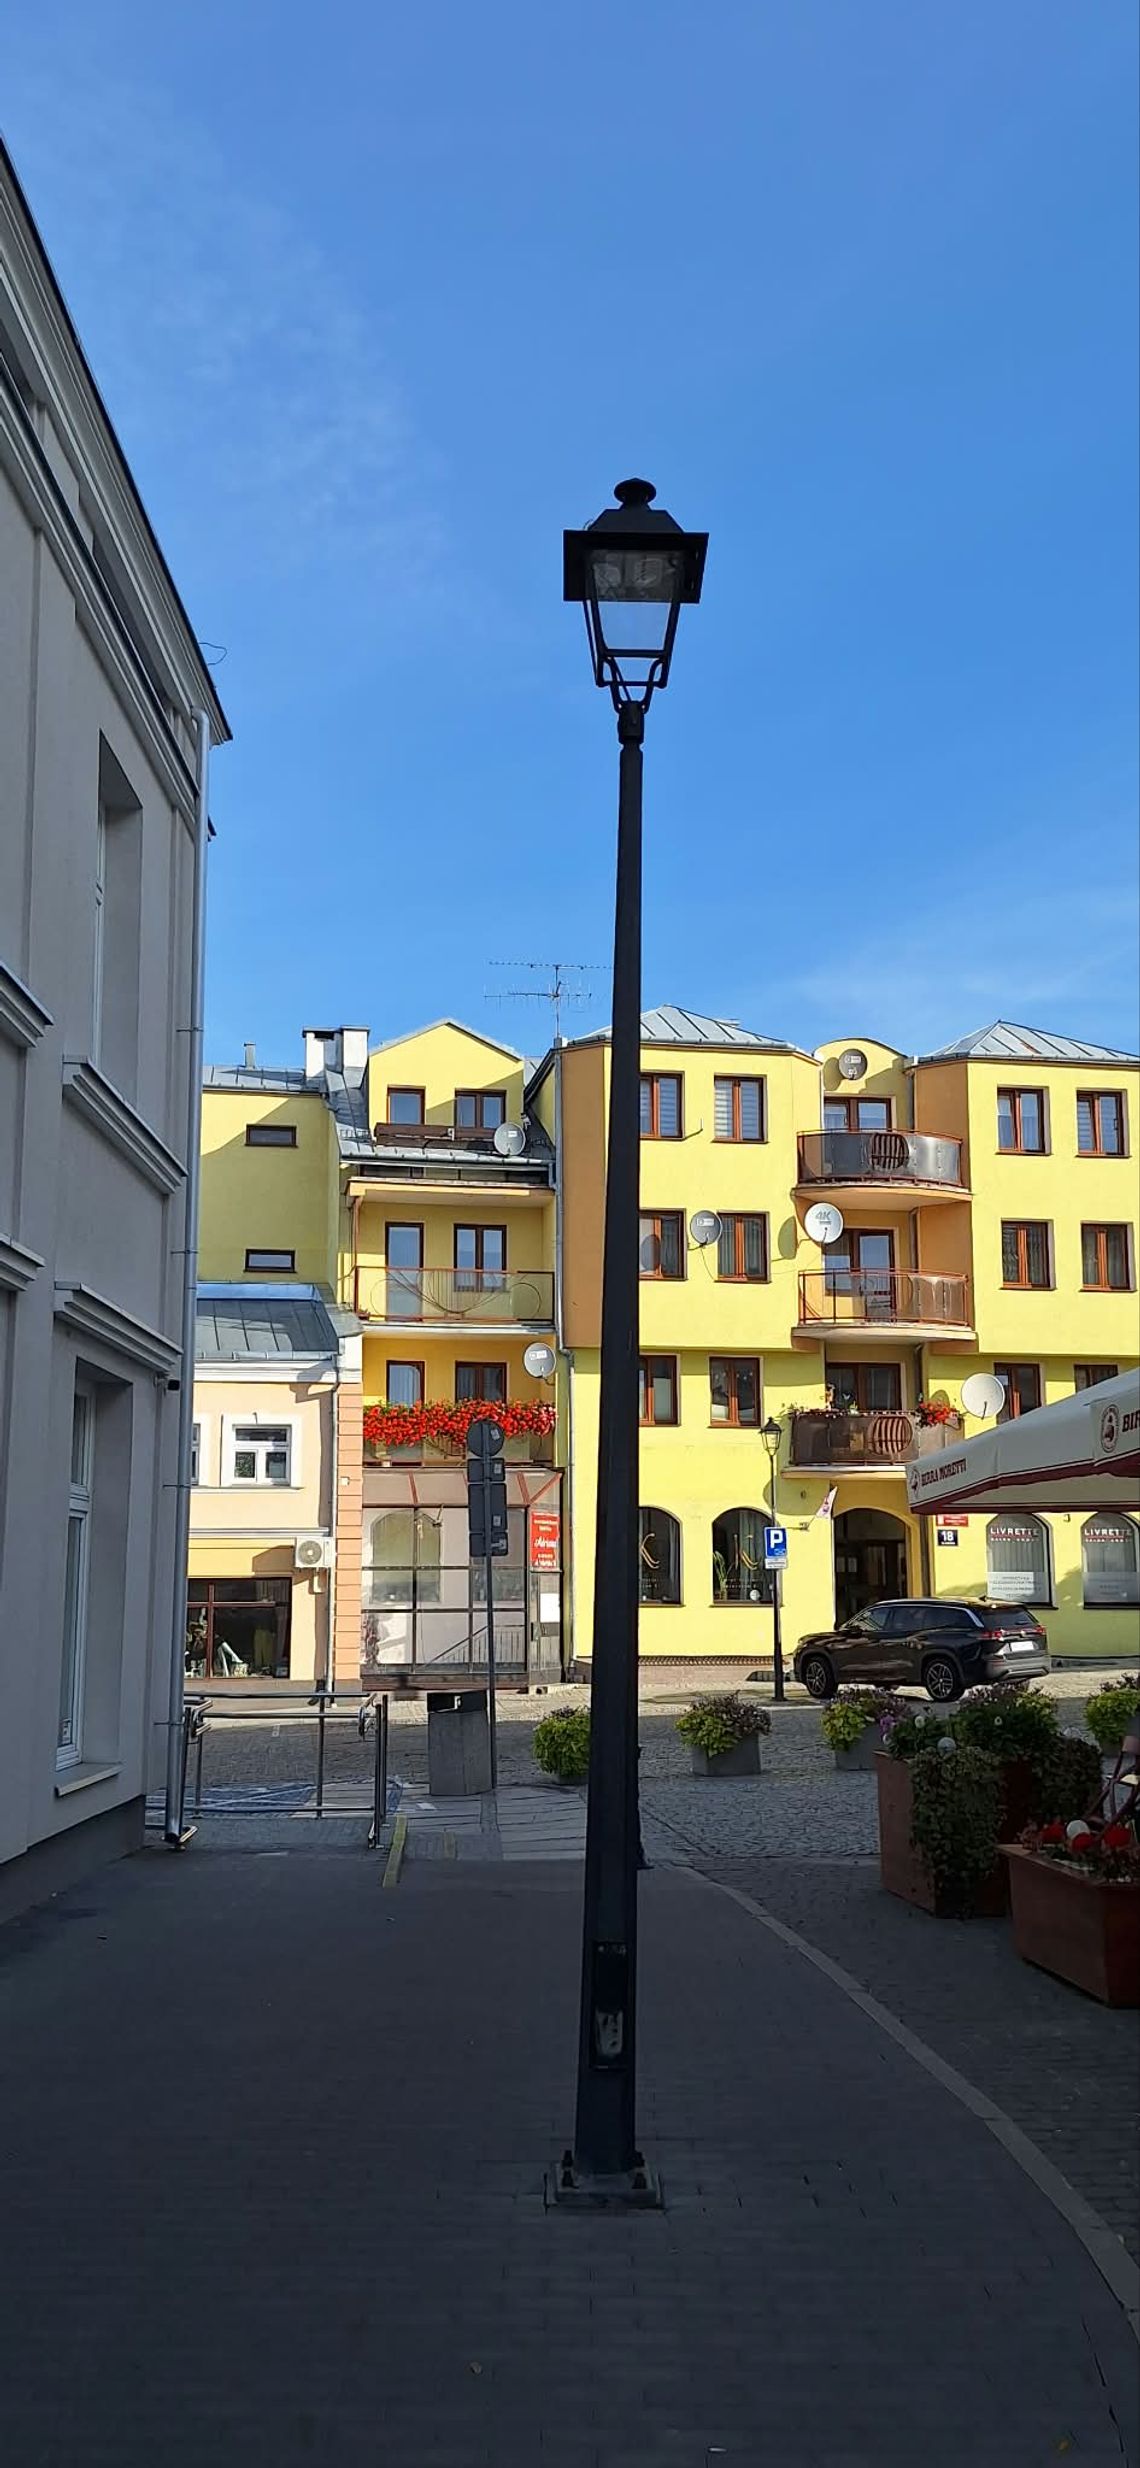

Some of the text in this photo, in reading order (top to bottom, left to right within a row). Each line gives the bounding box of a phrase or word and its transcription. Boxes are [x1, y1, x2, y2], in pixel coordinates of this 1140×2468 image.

[815, 1211, 831, 1221] 4K
[921, 1468, 939, 1487] BIRRA
[941, 1531, 954, 1542] 18
[990, 1527, 1039, 1536] LIVRETTE
[1084, 1528, 1132, 1536] LIVRETTE
[770, 1530, 783, 1548] P
